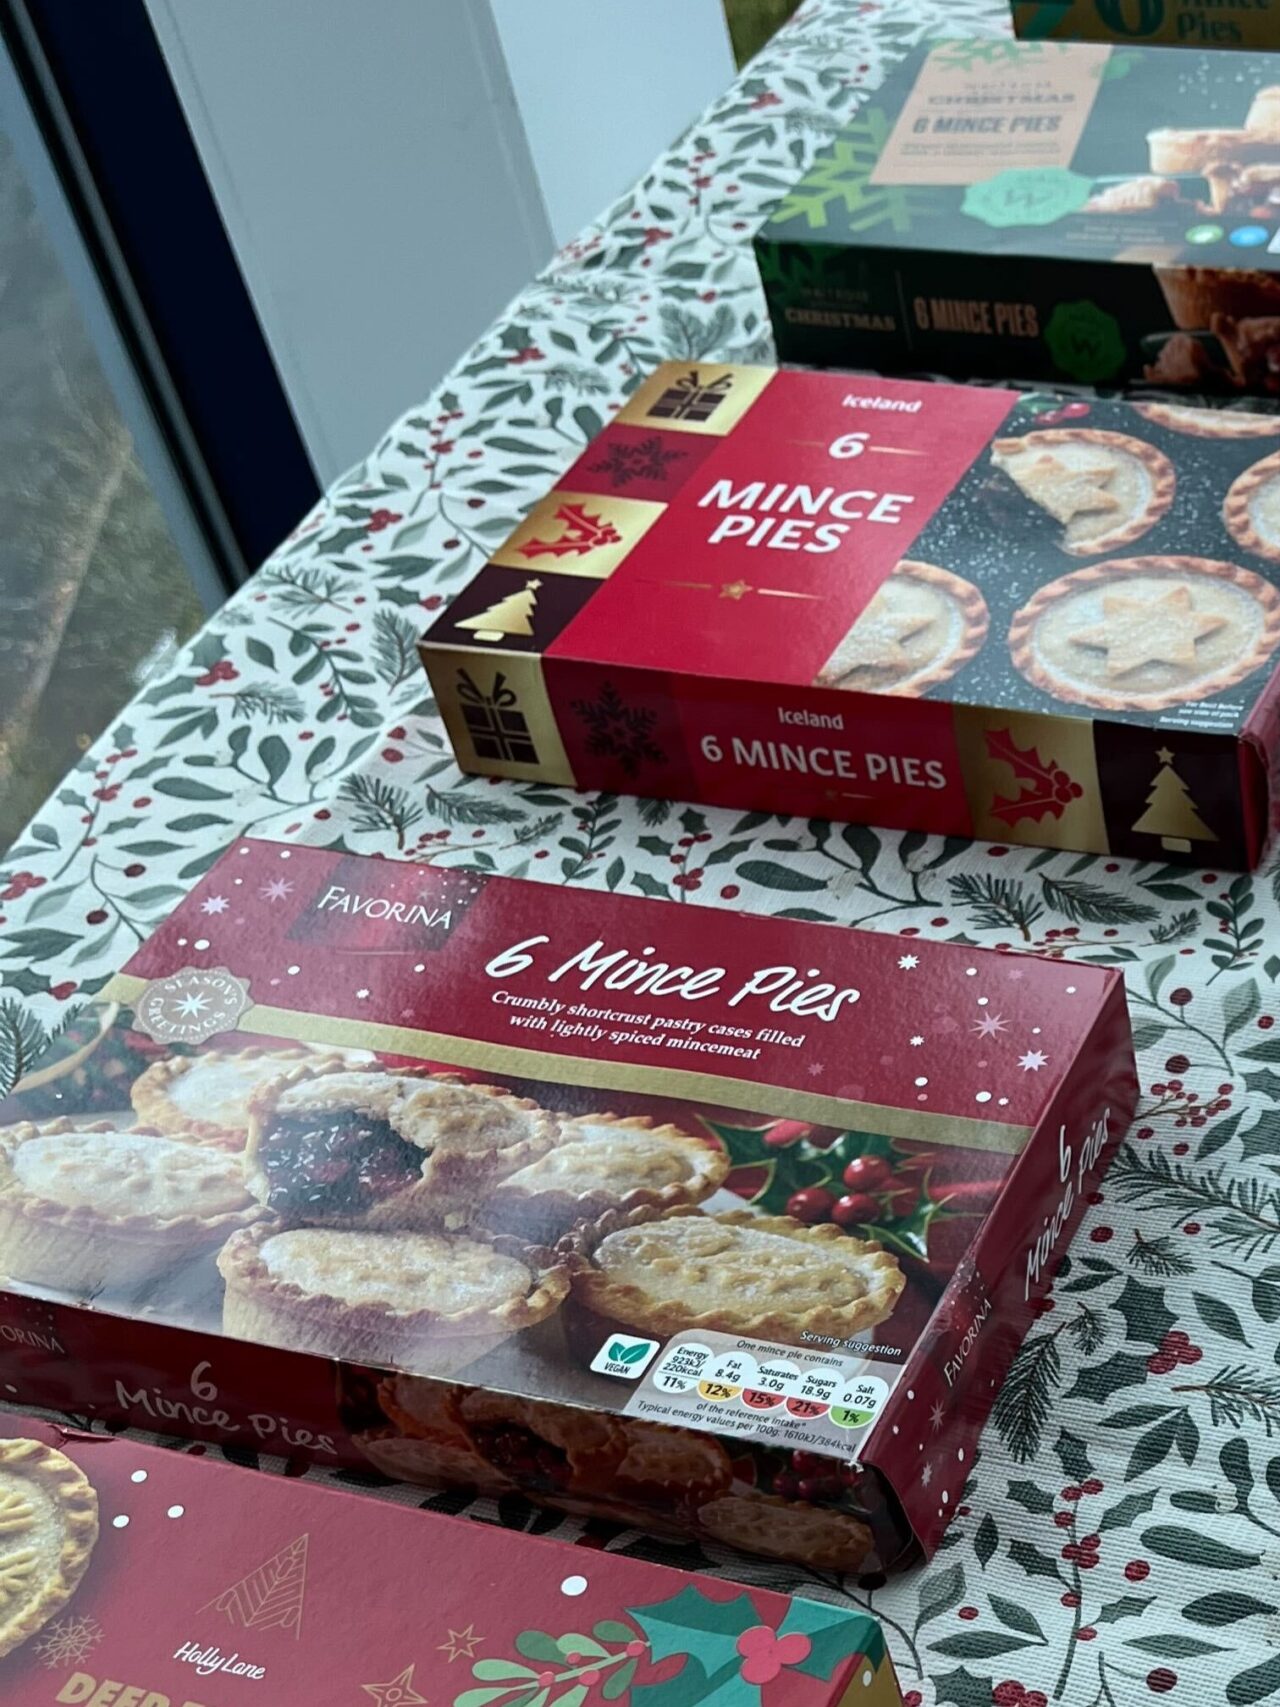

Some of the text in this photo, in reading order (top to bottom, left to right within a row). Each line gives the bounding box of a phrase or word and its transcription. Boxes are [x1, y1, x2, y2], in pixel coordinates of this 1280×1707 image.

[1176, 12, 1244, 42] Pies
[912, 115, 1063, 134] 6 MINCE PIES
[784, 307, 897, 332] CHRISTMAS
[913, 296, 1041, 339] 6 MINCE PIES
[841, 394, 923, 413] Iceland
[827, 432, 870, 459] 6
[697, 479, 914, 523] MINCE
[707, 515, 851, 553] PIES
[778, 707, 844, 731] Iceland
[1159, 716, 1234, 729] Serving suggestion
[701, 734, 948, 790] 6 MINCE PIES
[316, 885, 454, 930] FAVORINA
[485, 935, 862, 1023] 6 Mince Pies
[491, 989, 806, 1048] Crumbly shortcrust pastry cases filled
[509, 1014, 763, 1061] with lightly spiced mincemeat
[1059, 1124, 1072, 1184] 6
[1025, 1107, 1111, 1301] Mince Pies
[676, 1345, 710, 1362] Energy
[736, 1339, 845, 1368] One mince pie contains
[799, 1330, 903, 1357] Serving suggestion
[943, 1297, 993, 1388] FAVORINA
[603, 1361, 632, 1375] VEGAN
[661, 1362, 704, 1378] 220kcal
[672, 1354, 708, 1370] 923kJ/
[725, 1359, 743, 1371] Fat
[756, 1364, 800, 1382] Saturates
[190, 1360, 219, 1401] 6
[661, 1375, 688, 1392] 11%
[714, 1368, 741, 1384] 8.4g
[757, 1377, 786, 1393] 3.0g
[805, 1374, 838, 1389] Sugars
[703, 1382, 733, 1400] 12%
[749, 1391, 777, 1409] 15%
[800, 1384, 832, 1401] 18.9g
[842, 1393, 878, 1409] 0.07g
[855, 1383, 876, 1396] Salt
[113, 1379, 338, 1456] Mince Pies
[695, 1402, 709, 1412] of
[708, 1405, 725, 1415] the
[725, 1408, 773, 1424] reference
[792, 1401, 821, 1417] 21%
[841, 1409, 861, 1424] 1%
[637, 1401, 671, 1416] Typical
[671, 1408, 706, 1422] energy
[705, 1415, 738, 1430] values
[737, 1420, 755, 1434] per
[781, 1430, 858, 1454] 1610kJ/384kcal
[172, 1641, 266, 1680] Holly Lane
